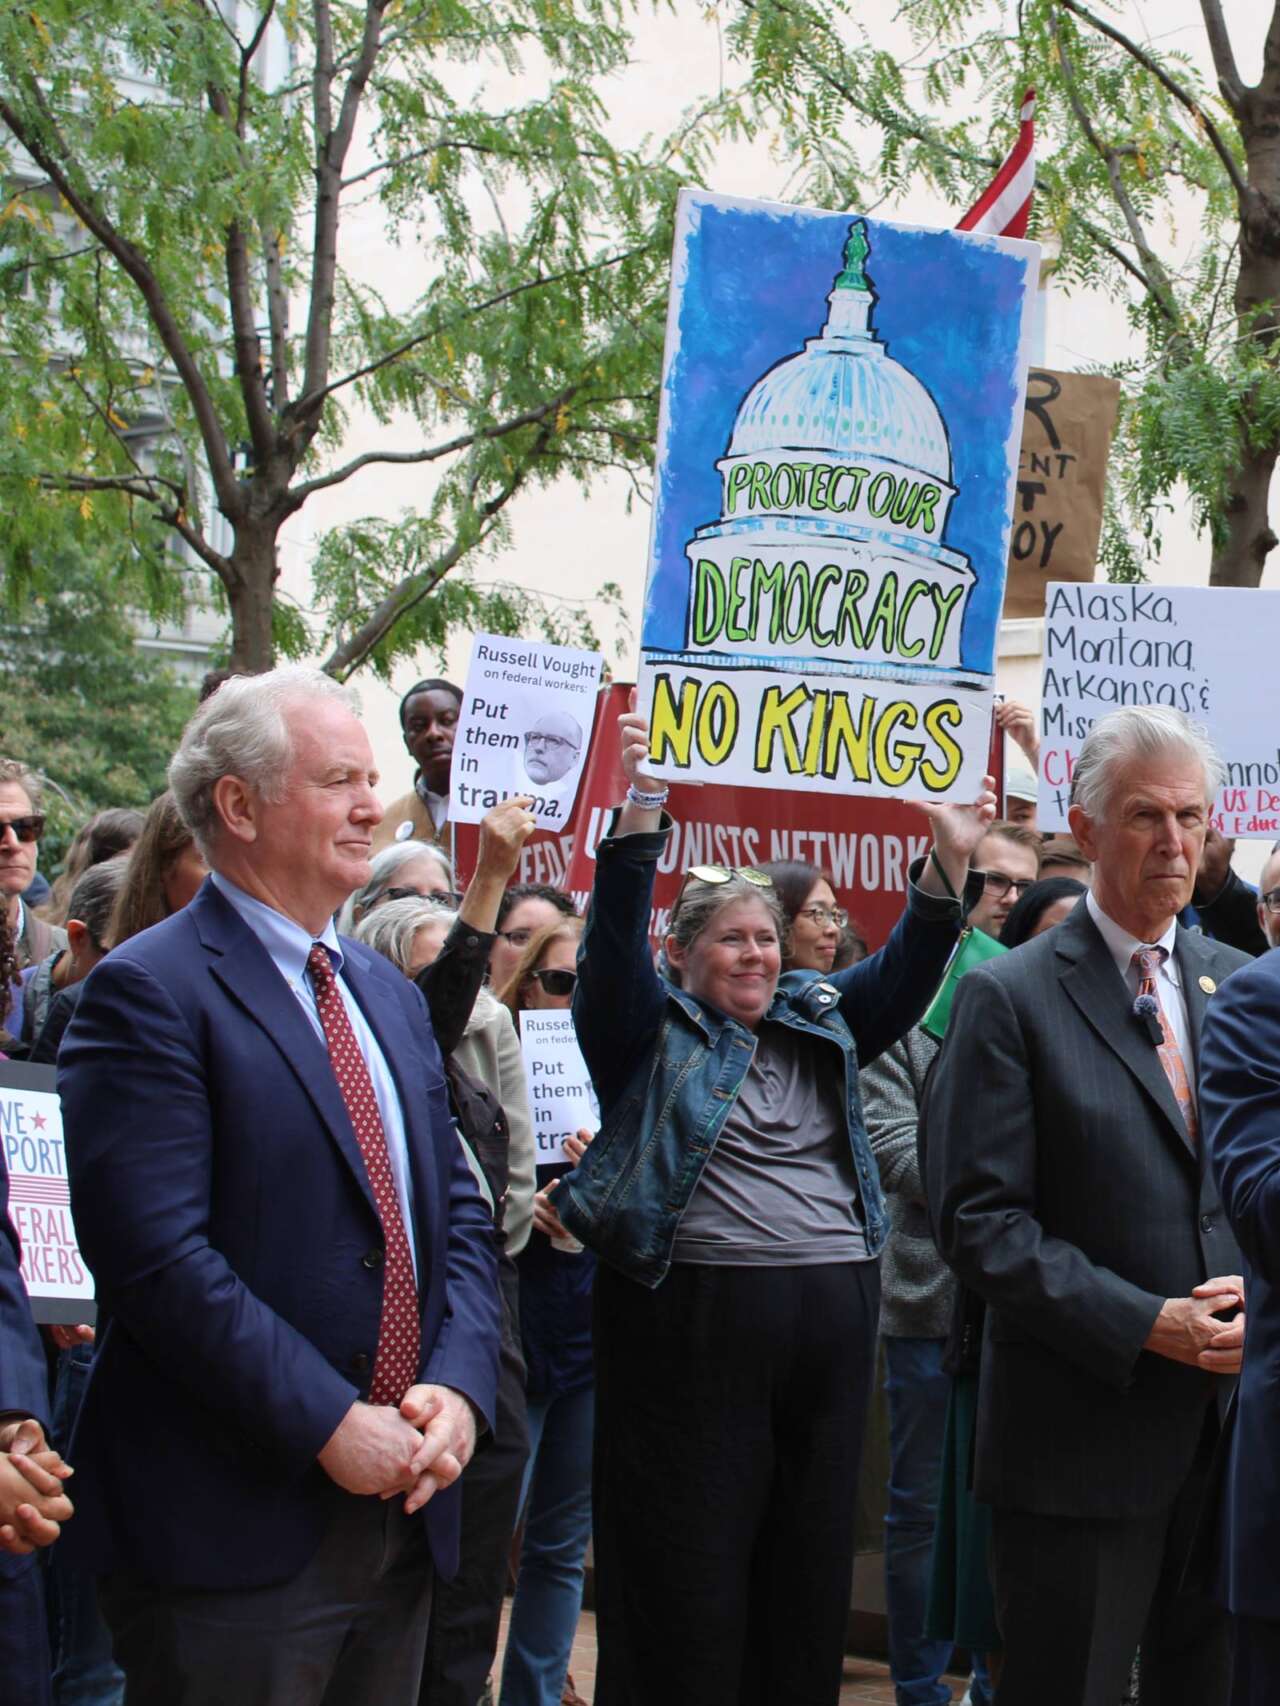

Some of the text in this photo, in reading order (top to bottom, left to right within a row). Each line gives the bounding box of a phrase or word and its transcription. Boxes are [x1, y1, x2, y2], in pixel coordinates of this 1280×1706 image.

[727, 462, 942, 534] PROTECT OUR
[1012, 521, 1063, 568] OY
[693, 557, 964, 660] DEMOCRACY
[1049, 586, 1177, 626] Alaska,
[477, 645, 596, 679] Russell Vought
[484, 669, 588, 694] on federal workers:
[471, 698, 509, 720] Put
[466, 727, 520, 749] them
[649, 673, 962, 792] NO KINGS
[460, 753, 479, 772] in
[1223, 789, 1248, 812] US
[532, 1061, 564, 1076] Put
[533, 1083, 583, 1099] them
[534, 1107, 552, 1122] in
[5, 1134, 62, 1174] PORT
[15, 1206, 76, 1246] ERAL
[21, 1246, 84, 1286] KERS
